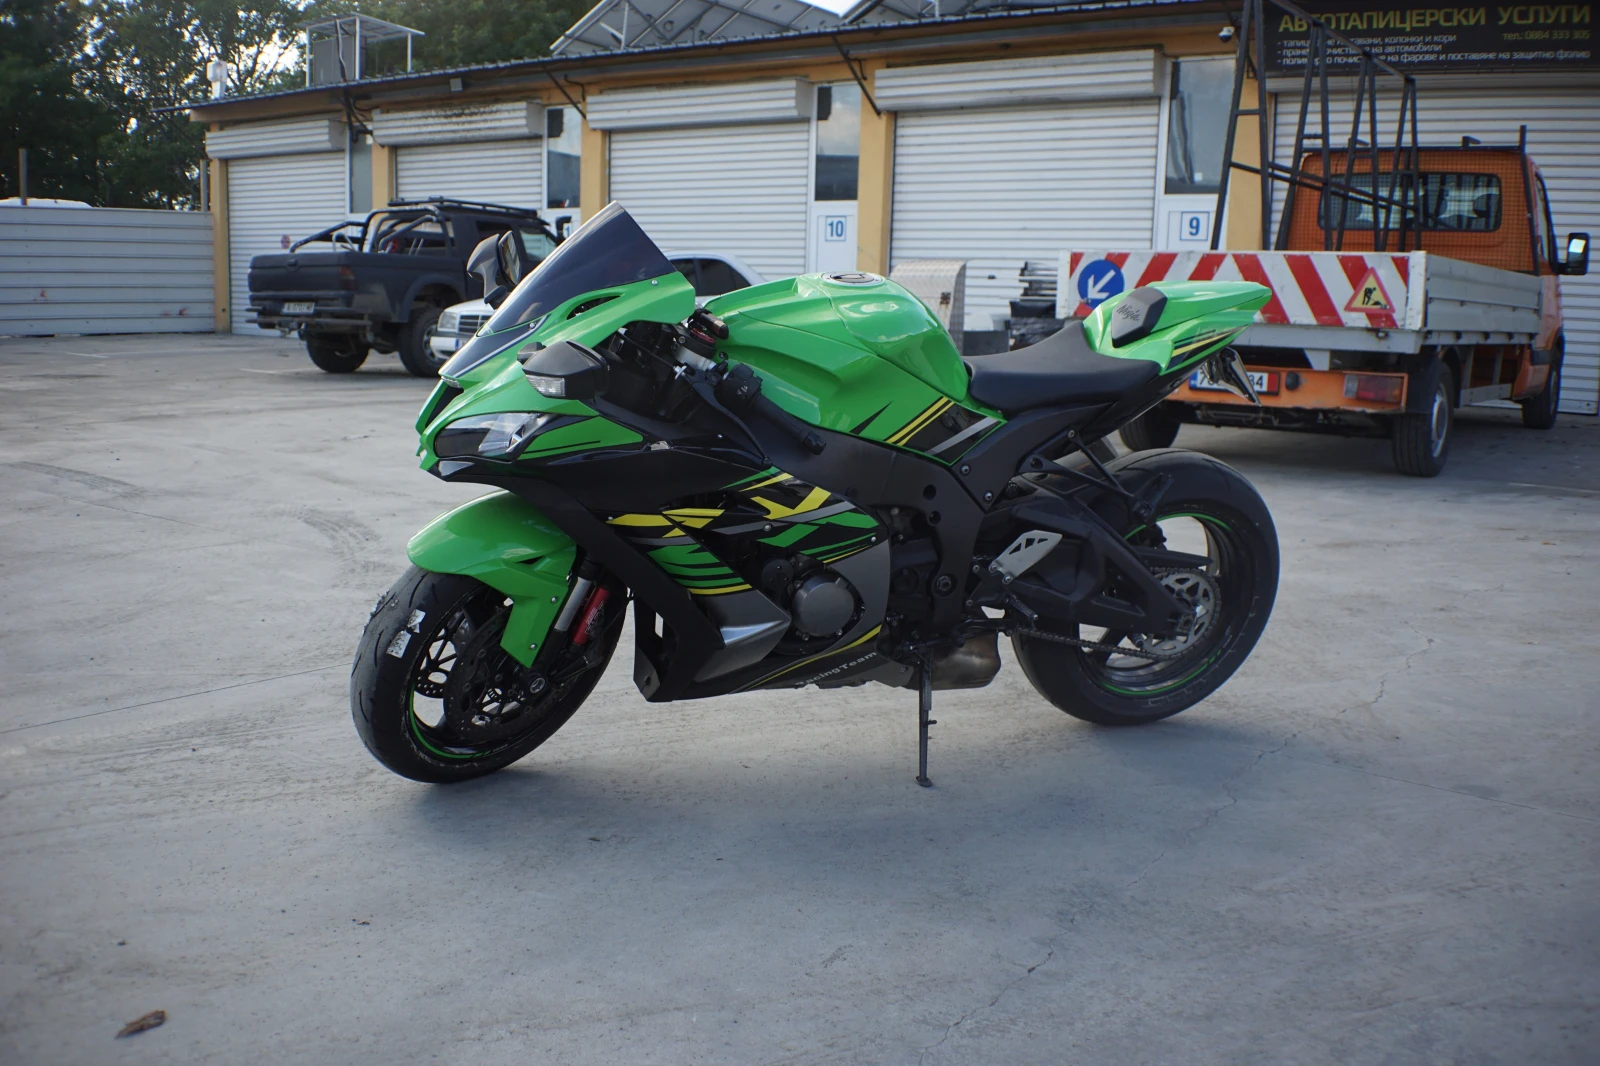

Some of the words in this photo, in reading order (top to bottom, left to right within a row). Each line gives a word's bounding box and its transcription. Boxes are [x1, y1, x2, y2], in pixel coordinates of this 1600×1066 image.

[1498, 6, 1590, 25] УСЛУГИ
[1433, 34, 1457, 44] кори
[1371, 46, 1383, 54] на
[1384, 43, 1442, 53] автомобили
[1387, 54, 1399, 62] на
[1400, 52, 1438, 63] фарове
[1447, 51, 1497, 61] поставяне
[1498, 51, 1511, 59] на
[828, 220, 844, 237] 10
[1189, 216, 1200, 236] 9
[1116, 303, 1140, 321] Ninja
